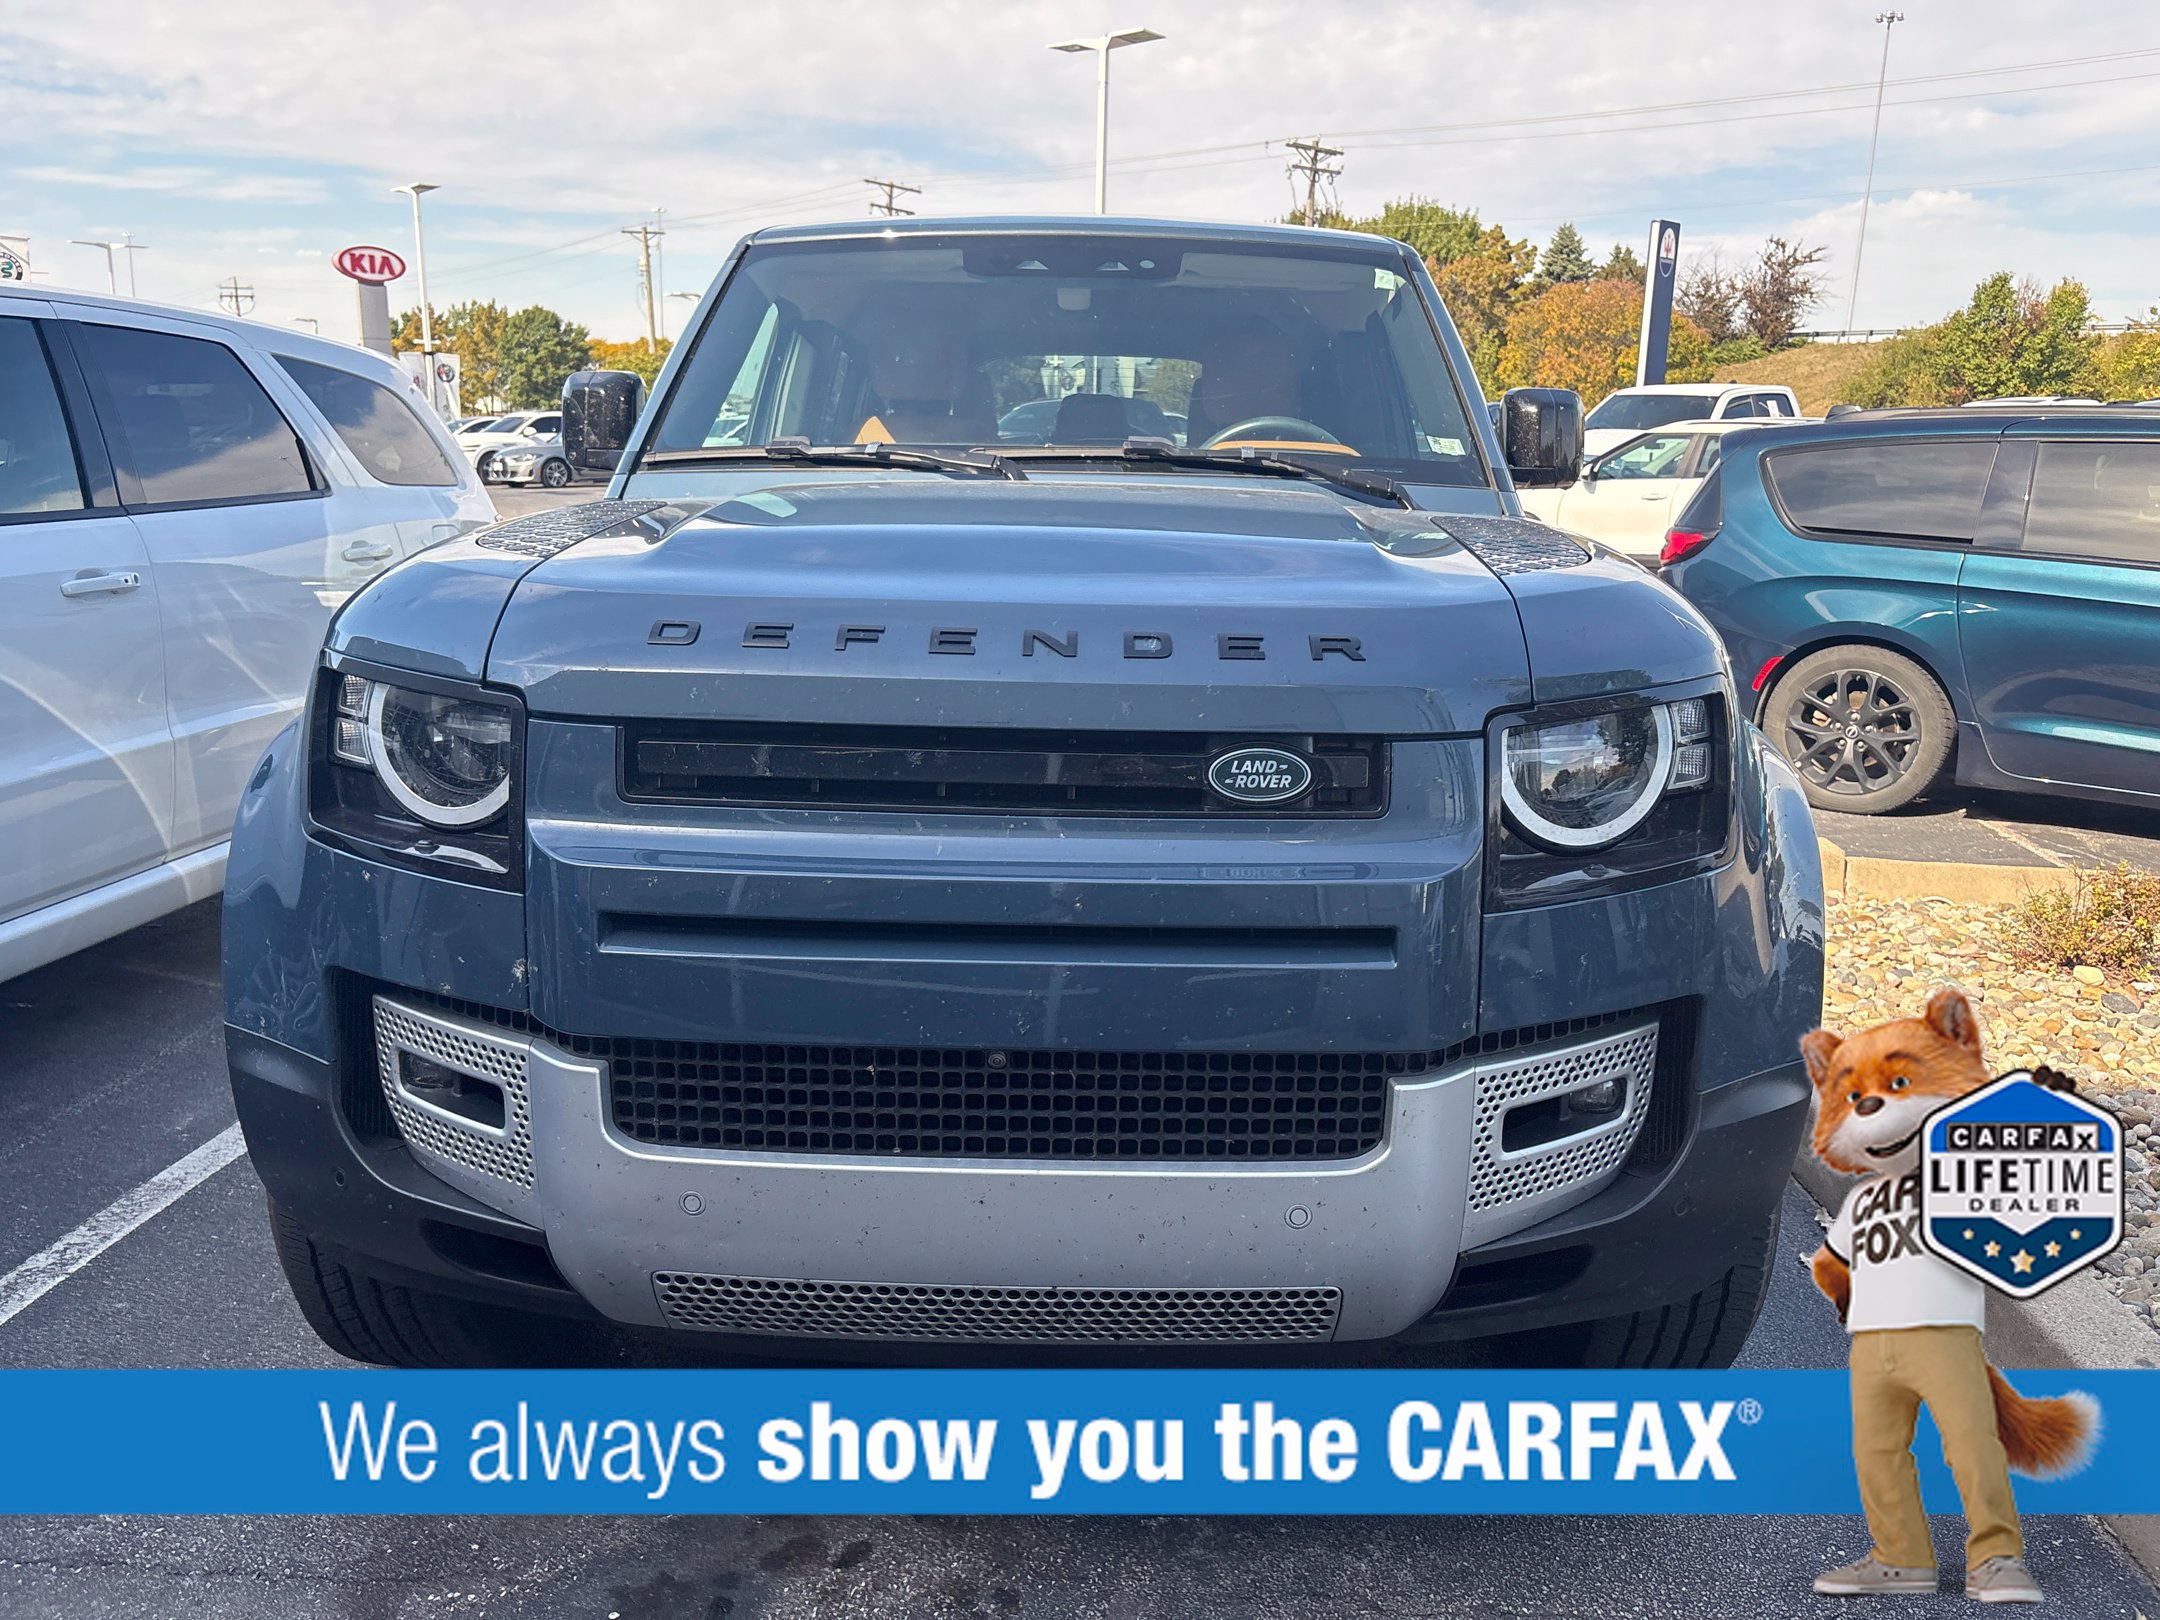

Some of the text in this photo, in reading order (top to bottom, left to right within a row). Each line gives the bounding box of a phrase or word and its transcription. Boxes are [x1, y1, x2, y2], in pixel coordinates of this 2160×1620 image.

[350, 253, 396, 276] KIA
[647, 619, 1367, 662] DEFENDER
[1230, 760, 1277, 773] LAND
[1235, 775, 1292, 788] ROVER
